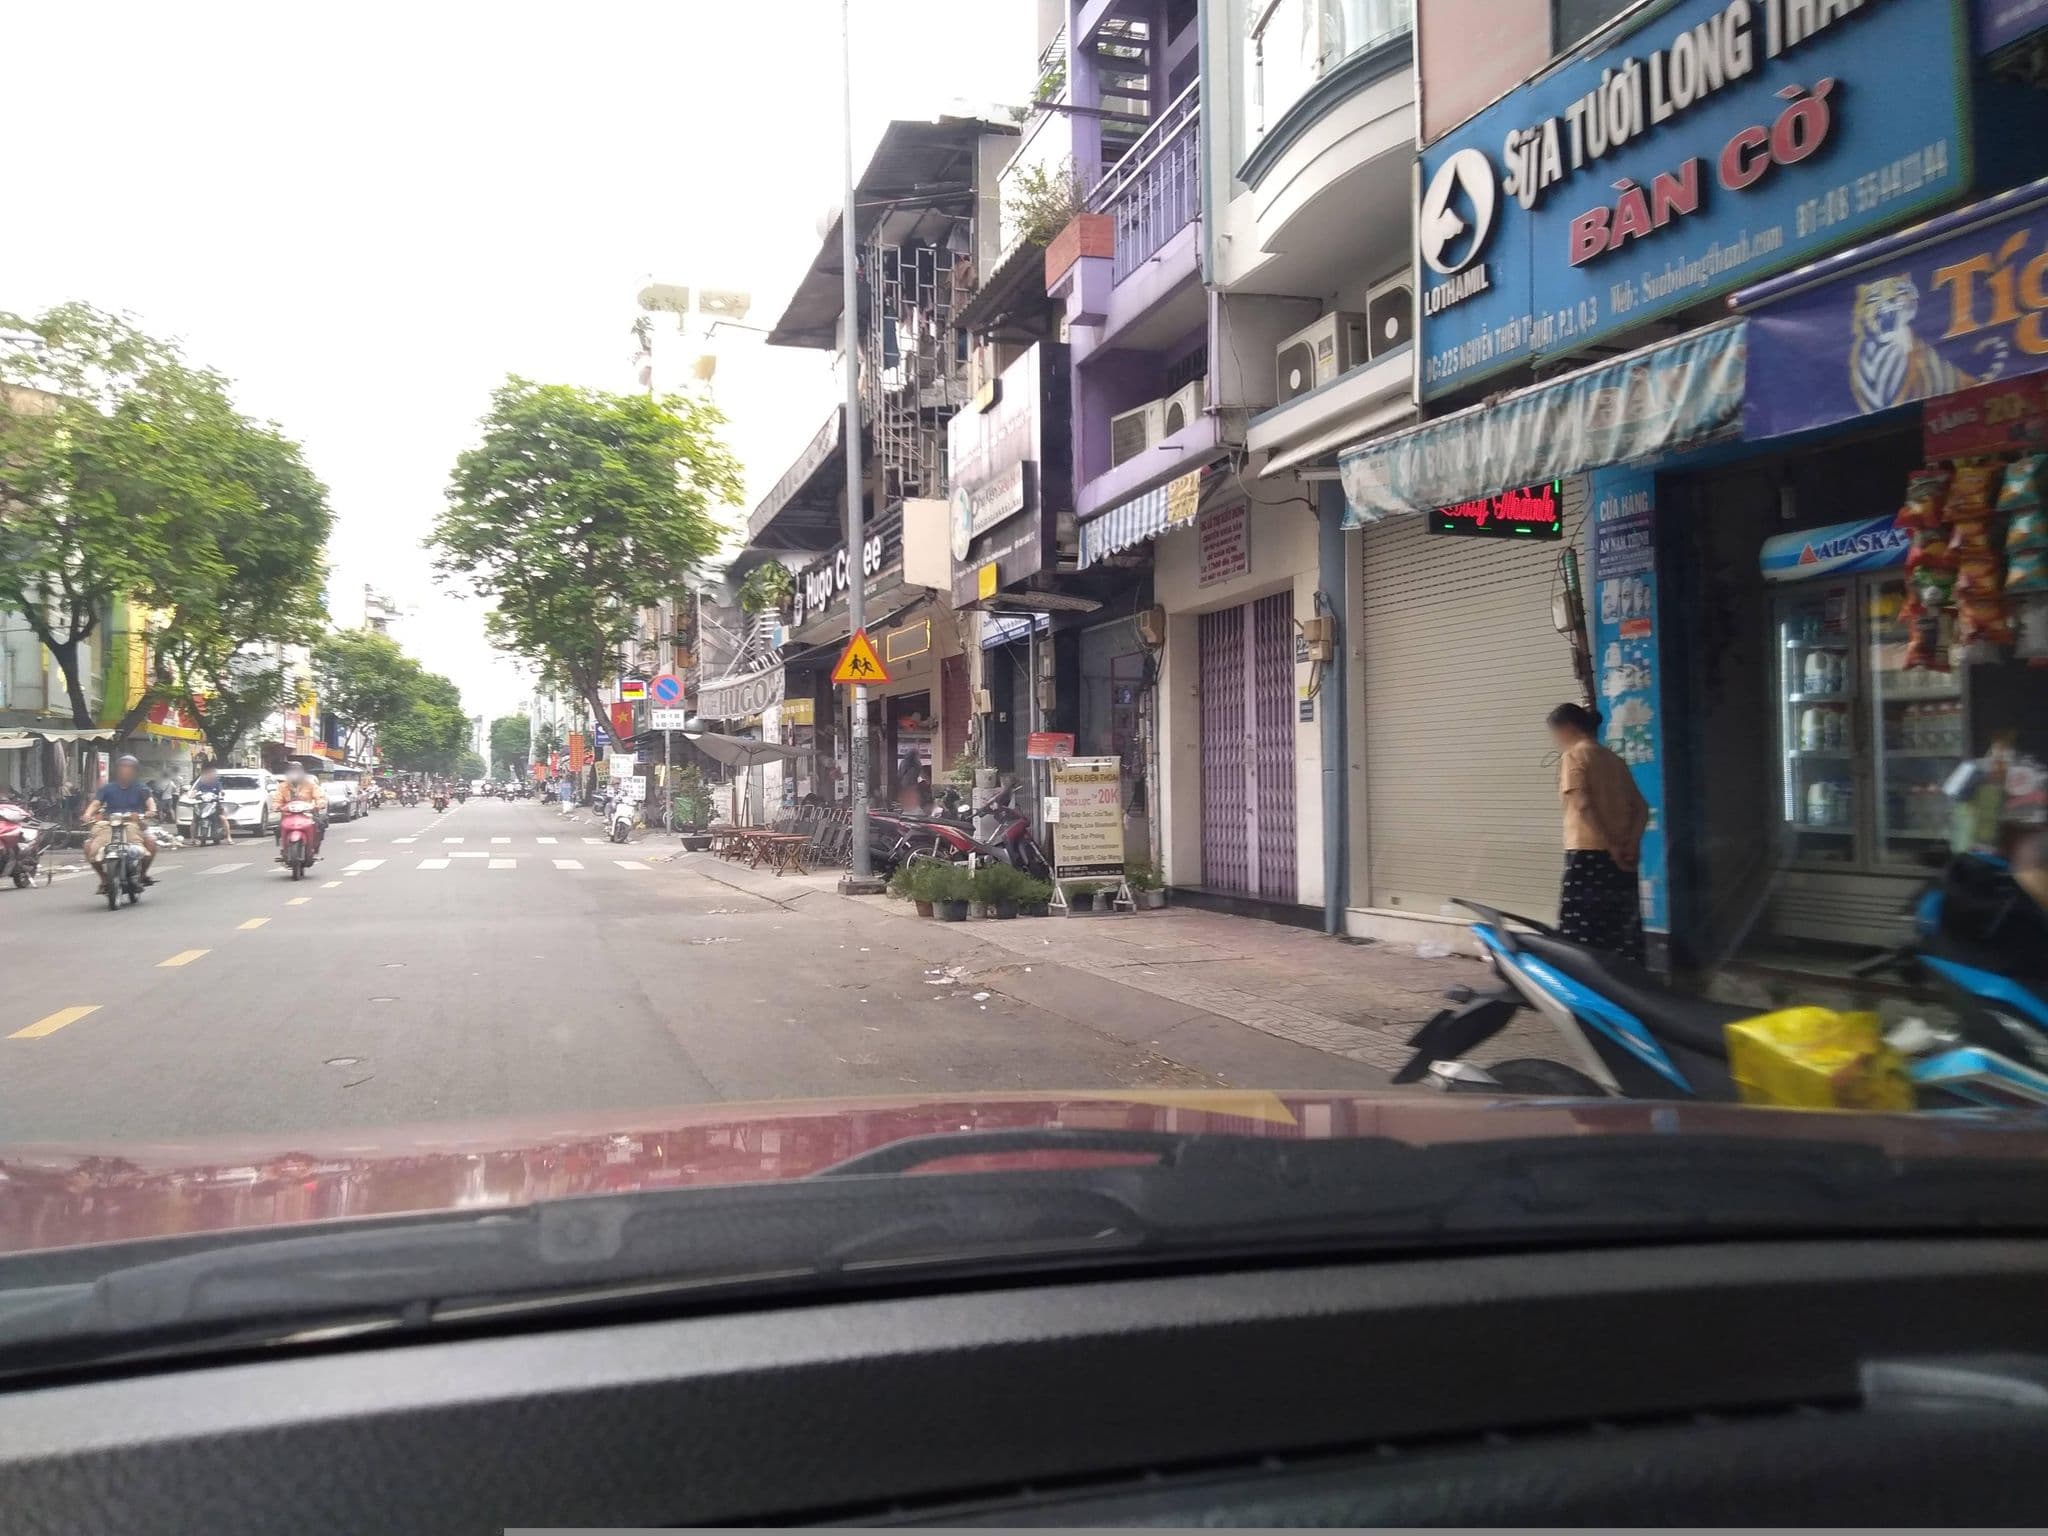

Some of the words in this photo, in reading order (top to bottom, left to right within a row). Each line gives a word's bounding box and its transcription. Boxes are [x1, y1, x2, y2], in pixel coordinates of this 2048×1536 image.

[1503, 117, 1563, 210] SỮA
[1650, 0, 1752, 126] LONG
[1568, 157, 1698, 268] BÀN
[1716, 76, 1835, 192] CỜ
[1424, 263, 1489, 316] LOTHAMIL
[1817, 528, 1901, 561] ALASKA
[806, 567, 833, 612] Hugo
[720, 679, 768, 716] HUGO
[1098, 788, 1119, 804] 20K
